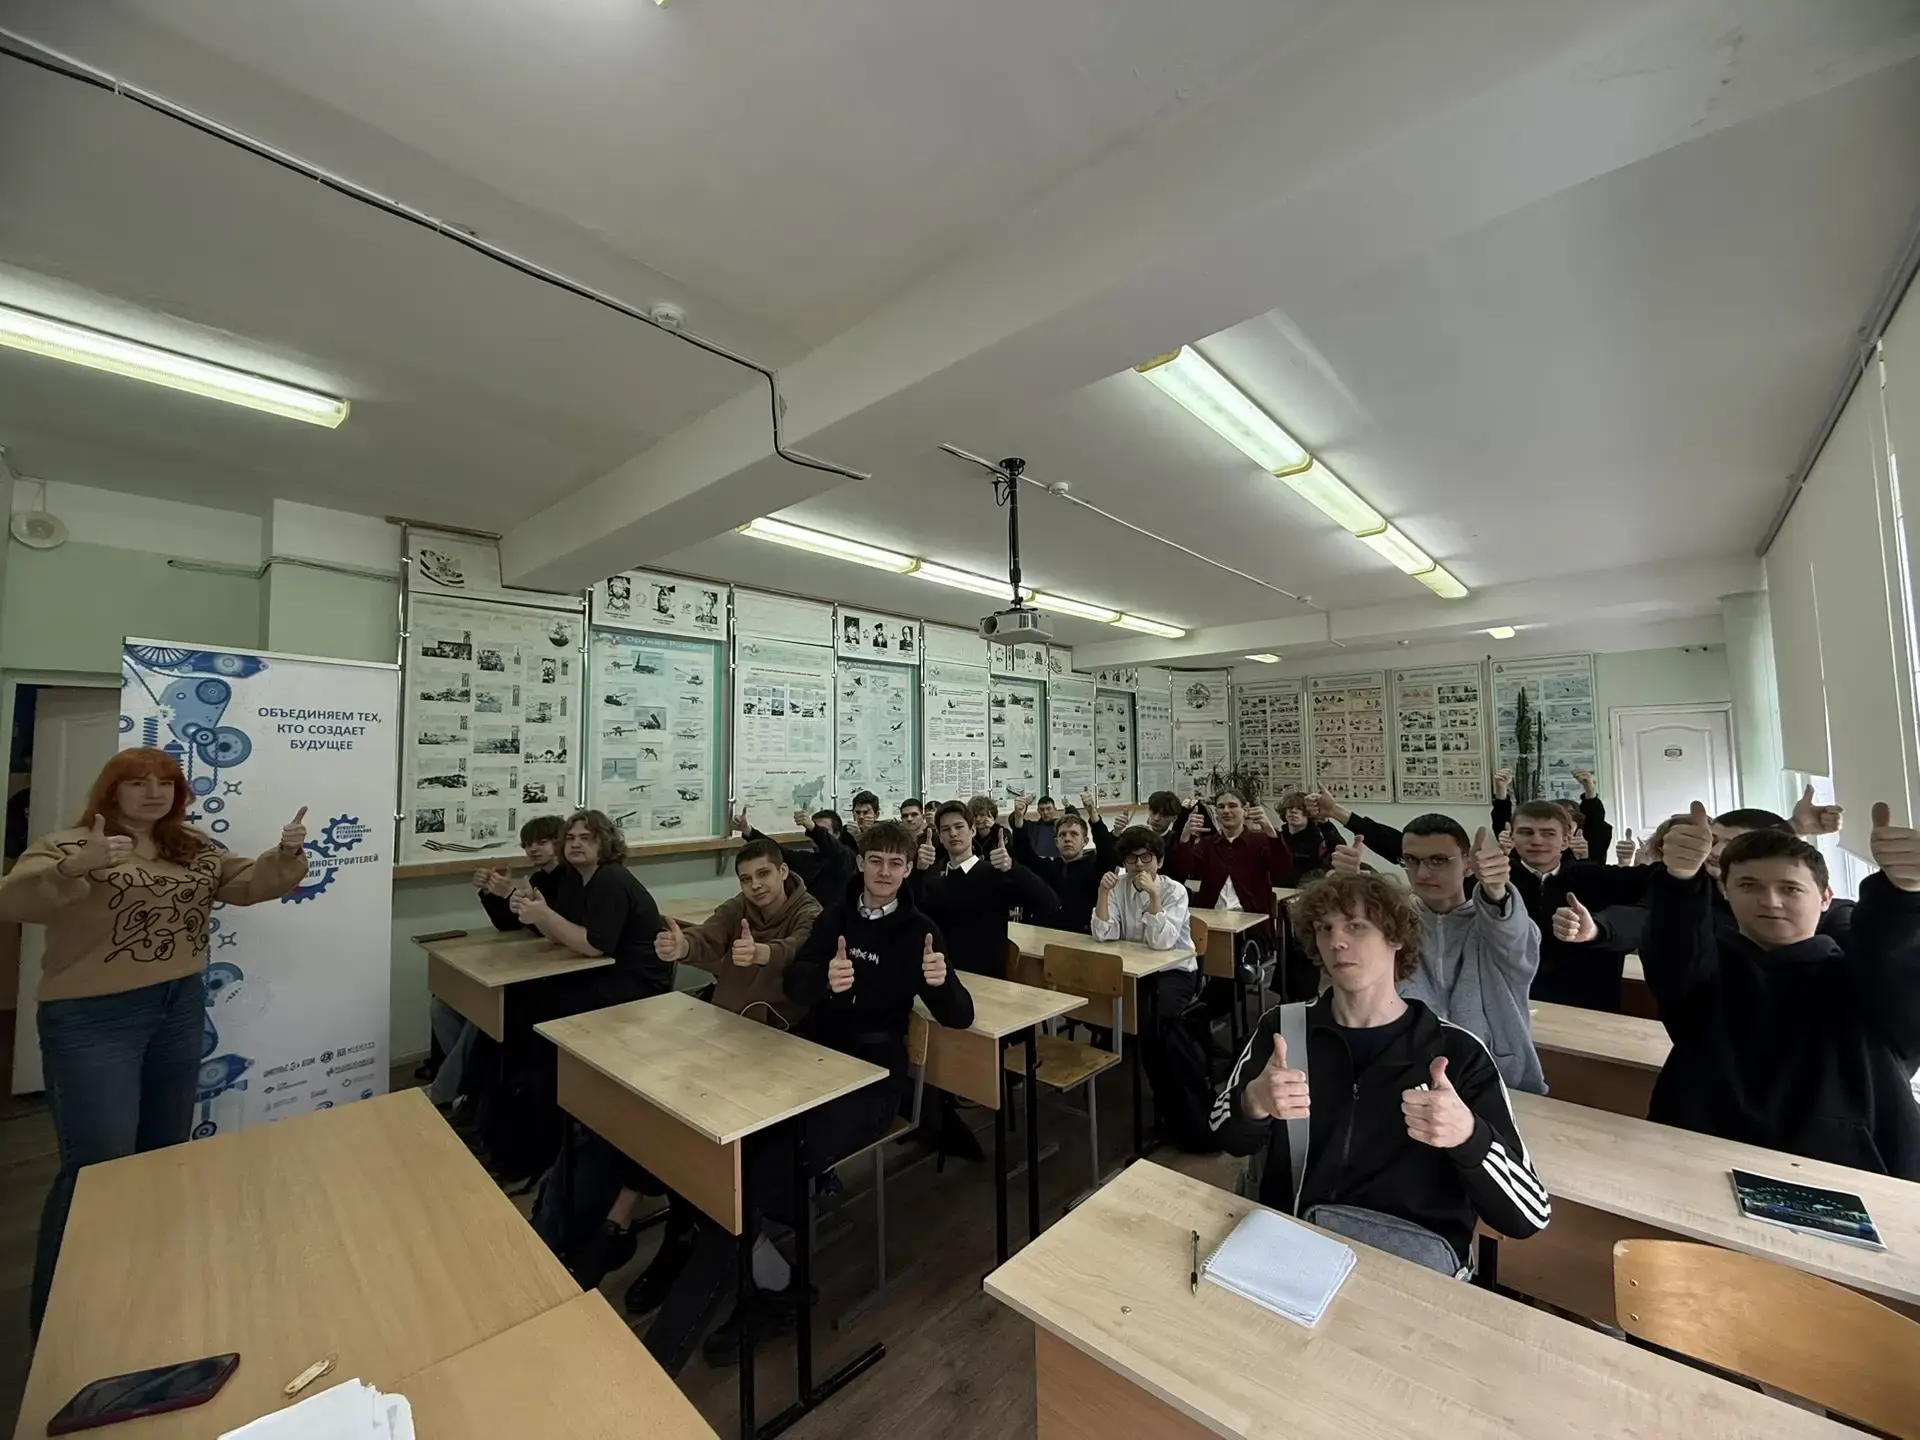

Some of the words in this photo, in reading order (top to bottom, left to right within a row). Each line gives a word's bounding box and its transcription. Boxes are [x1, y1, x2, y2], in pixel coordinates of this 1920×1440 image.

[258, 707, 354, 721] ОБЪЕДИНЯЕМ
[357, 712, 382, 724] ТЕХ,
[277, 724, 304, 734] КТО
[308, 724, 366, 737] СОЗДАЕТ
[290, 739, 353, 751] БУДУЩЕЕ
[309, 853, 379, 868] ИНОСТРОИТЕЛЕЙ
